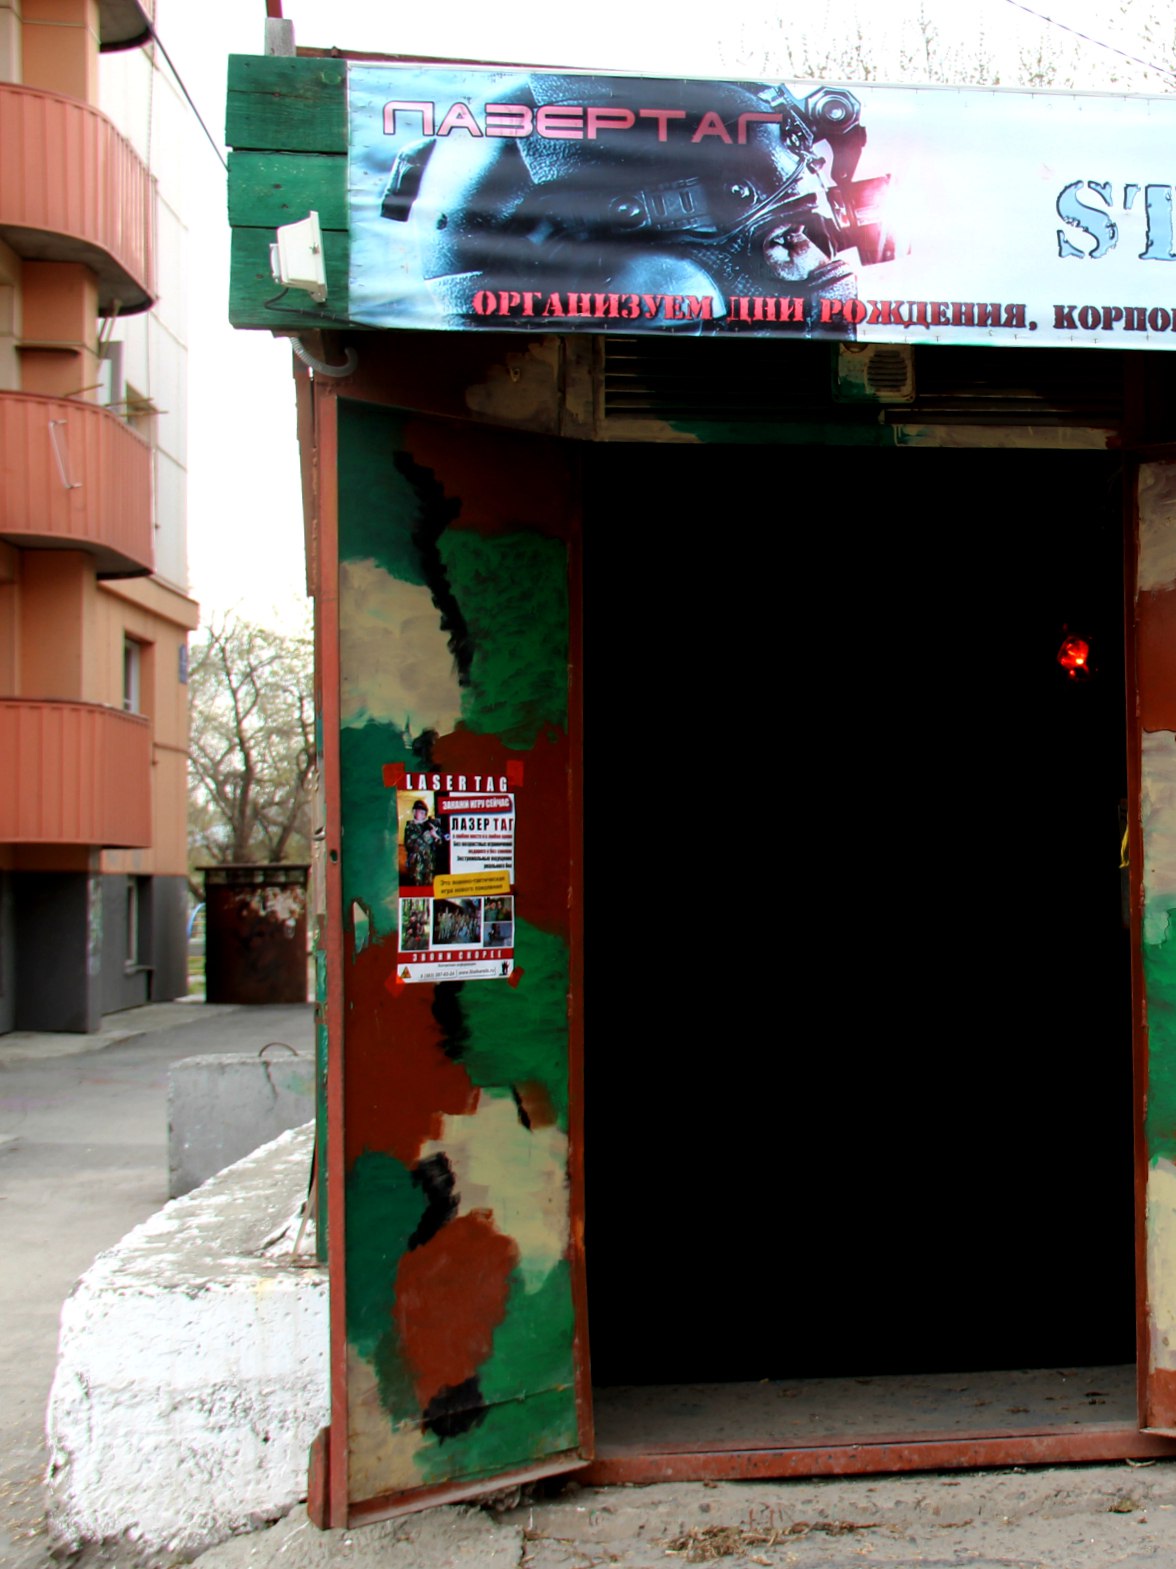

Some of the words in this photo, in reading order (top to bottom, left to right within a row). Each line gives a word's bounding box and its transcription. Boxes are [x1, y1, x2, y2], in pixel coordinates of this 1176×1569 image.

[472, 289, 714, 322] ОРГАНИЗУЕМ
[726, 295, 804, 325] ДНИ
[820, 298, 1038, 333] РОЖДЕНИЯ,
[405, 774, 467, 791] LASER
[474, 775, 508, 792] TAG
[451, 817, 490, 832] ЛАЗЕР
[493, 817, 514, 832] ТАГ
